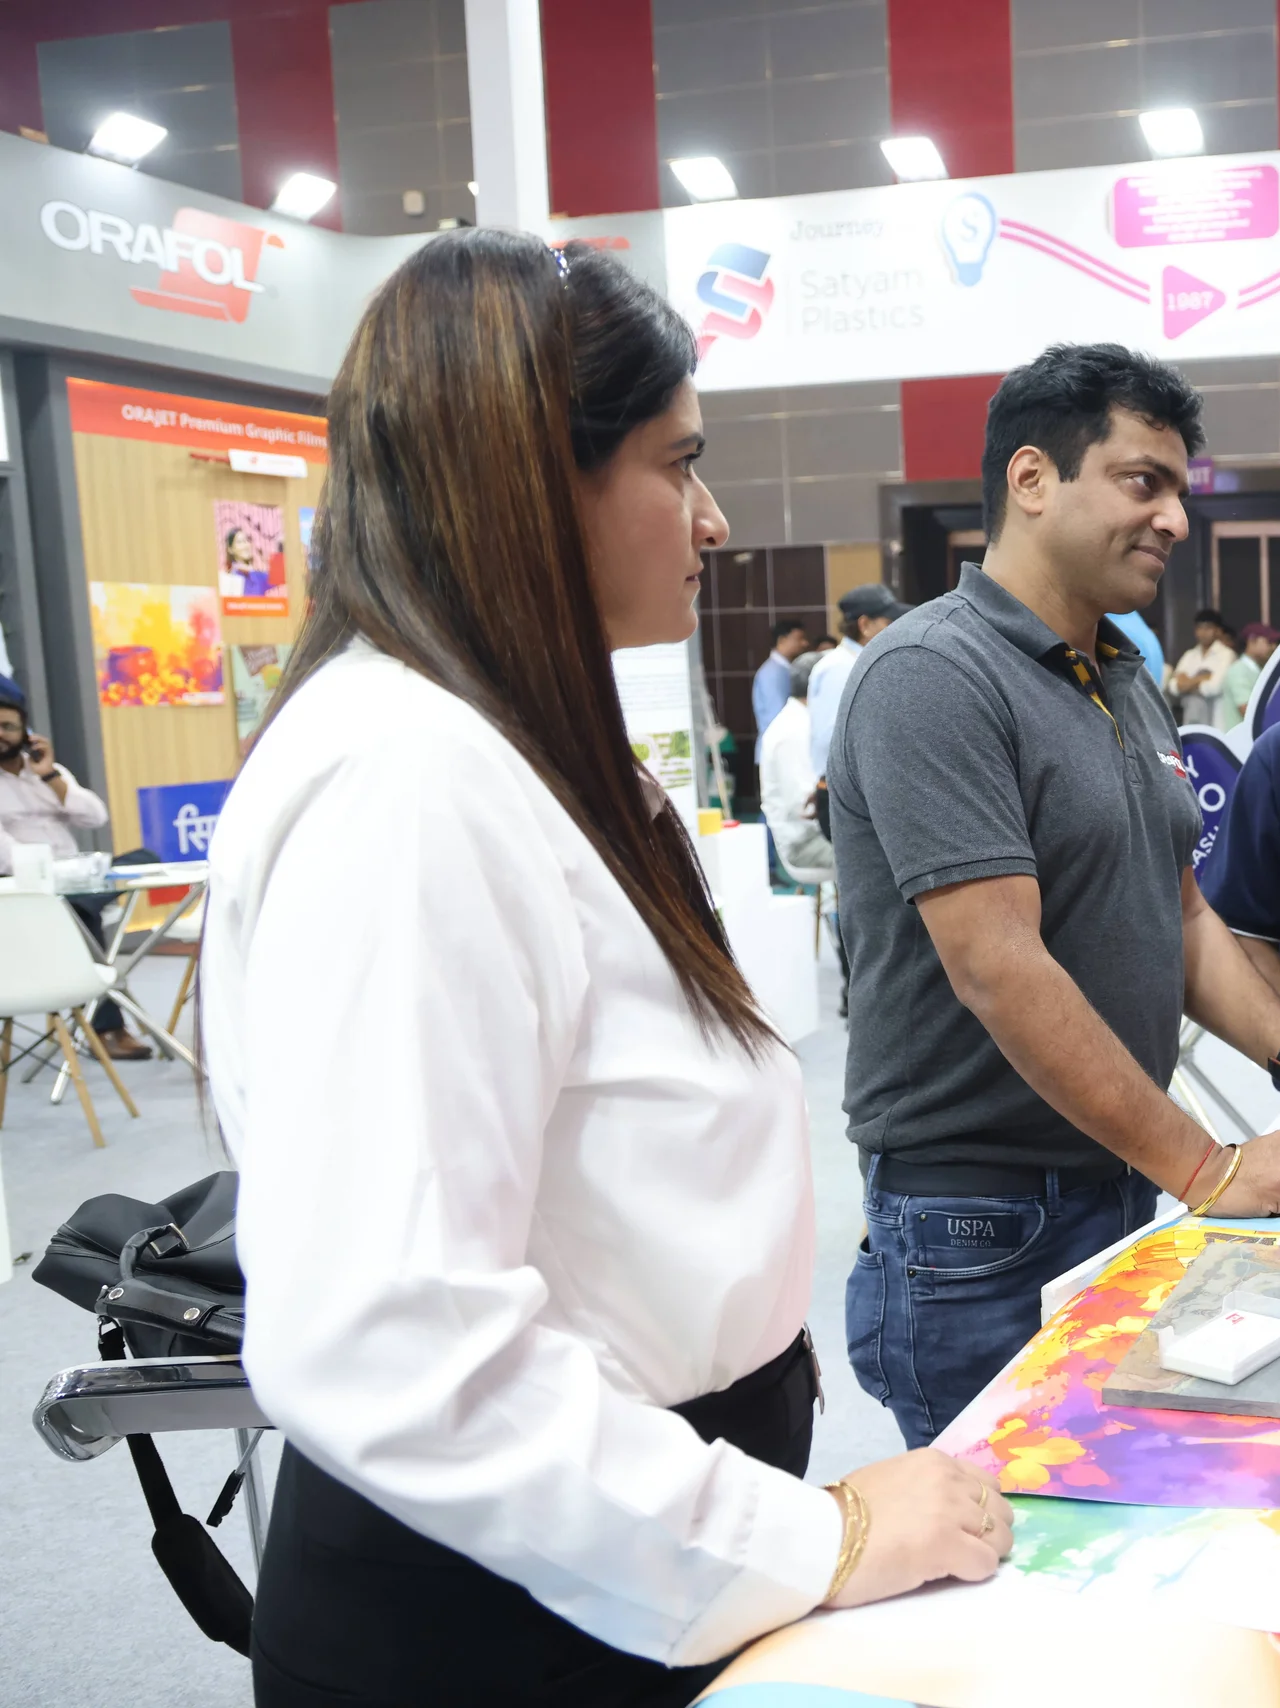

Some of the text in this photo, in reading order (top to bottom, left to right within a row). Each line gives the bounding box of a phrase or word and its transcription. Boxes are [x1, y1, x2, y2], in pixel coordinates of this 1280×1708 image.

[40, 199, 266, 295] ORAFOL
[800, 264, 926, 302] Satyam
[800, 302, 927, 336] Plastics
[121, 404, 178, 428] ORAJET
[180, 412, 244, 437] Premium
[246, 423, 296, 445] Graphic
[947, 1218, 996, 1237] USPA
[950, 1238, 978, 1248] DENIM
